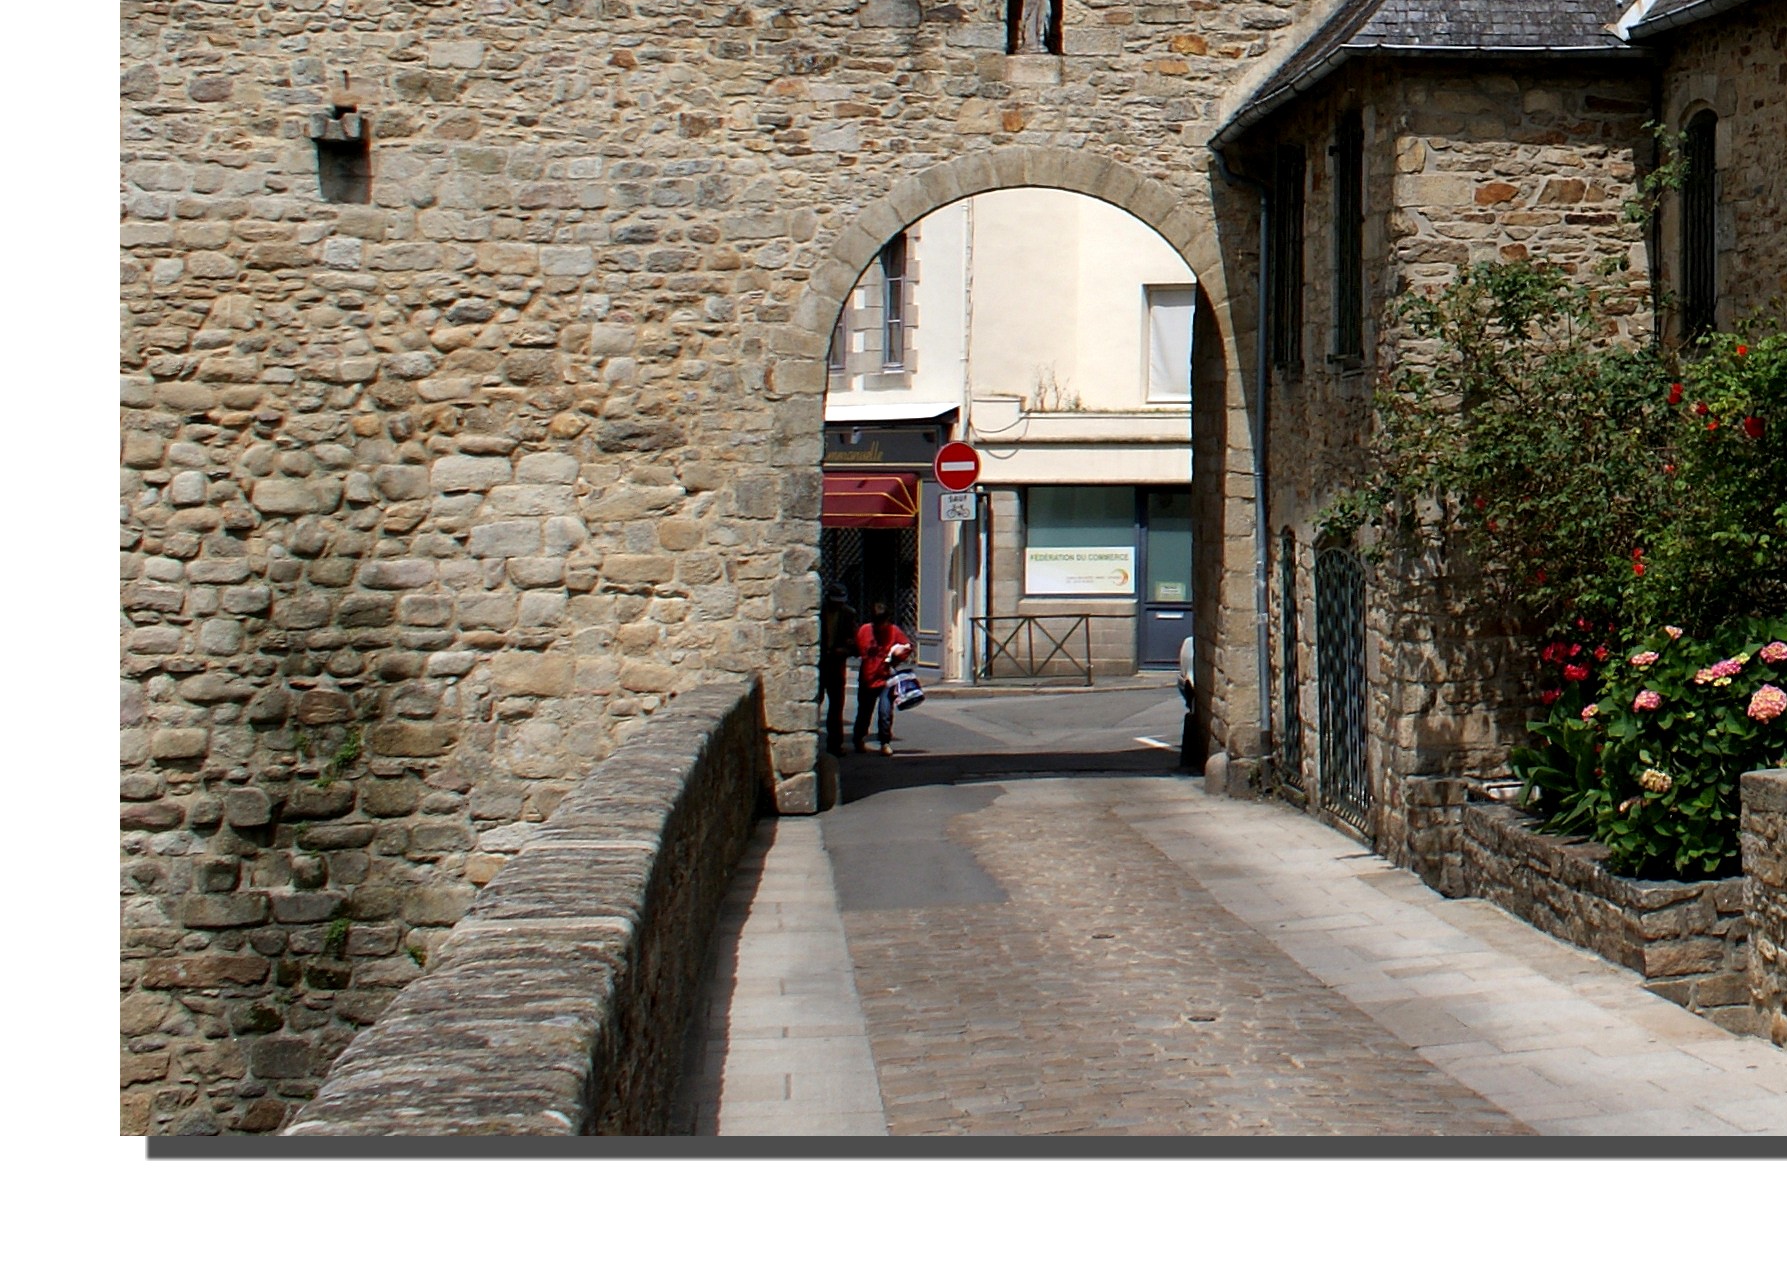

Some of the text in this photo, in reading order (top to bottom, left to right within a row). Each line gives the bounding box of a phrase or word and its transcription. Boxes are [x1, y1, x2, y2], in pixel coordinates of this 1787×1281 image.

[824, 439, 884, 461] mmanuelle
[1077, 553, 1087, 561] DU
[1089, 553, 1129, 561] COMMERCE
